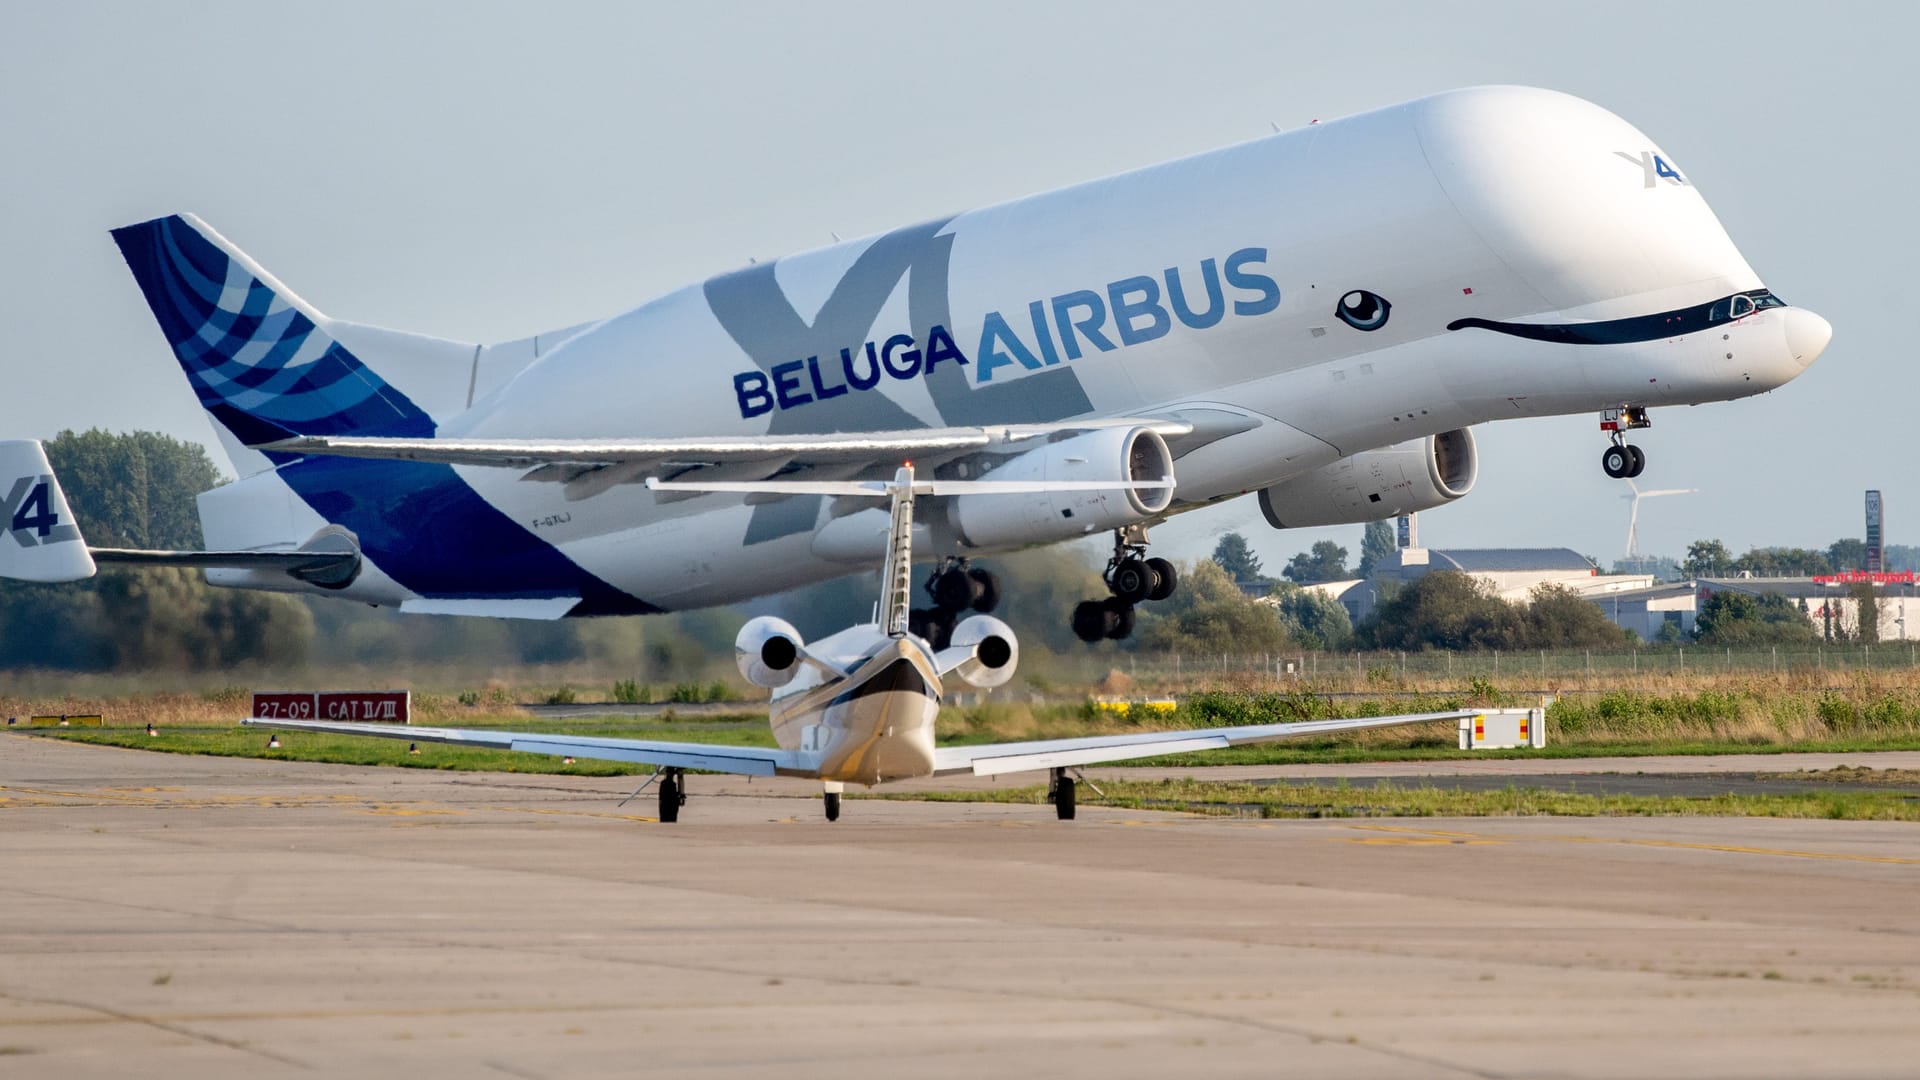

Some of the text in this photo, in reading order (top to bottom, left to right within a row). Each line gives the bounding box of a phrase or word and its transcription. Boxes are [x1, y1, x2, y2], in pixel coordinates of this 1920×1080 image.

[733, 247, 1281, 419] BELUGA AIRBUS
[1604, 410, 1618, 421] LJ
[260, 702, 310, 719] 27-09
[328, 701, 358, 719] CAT
